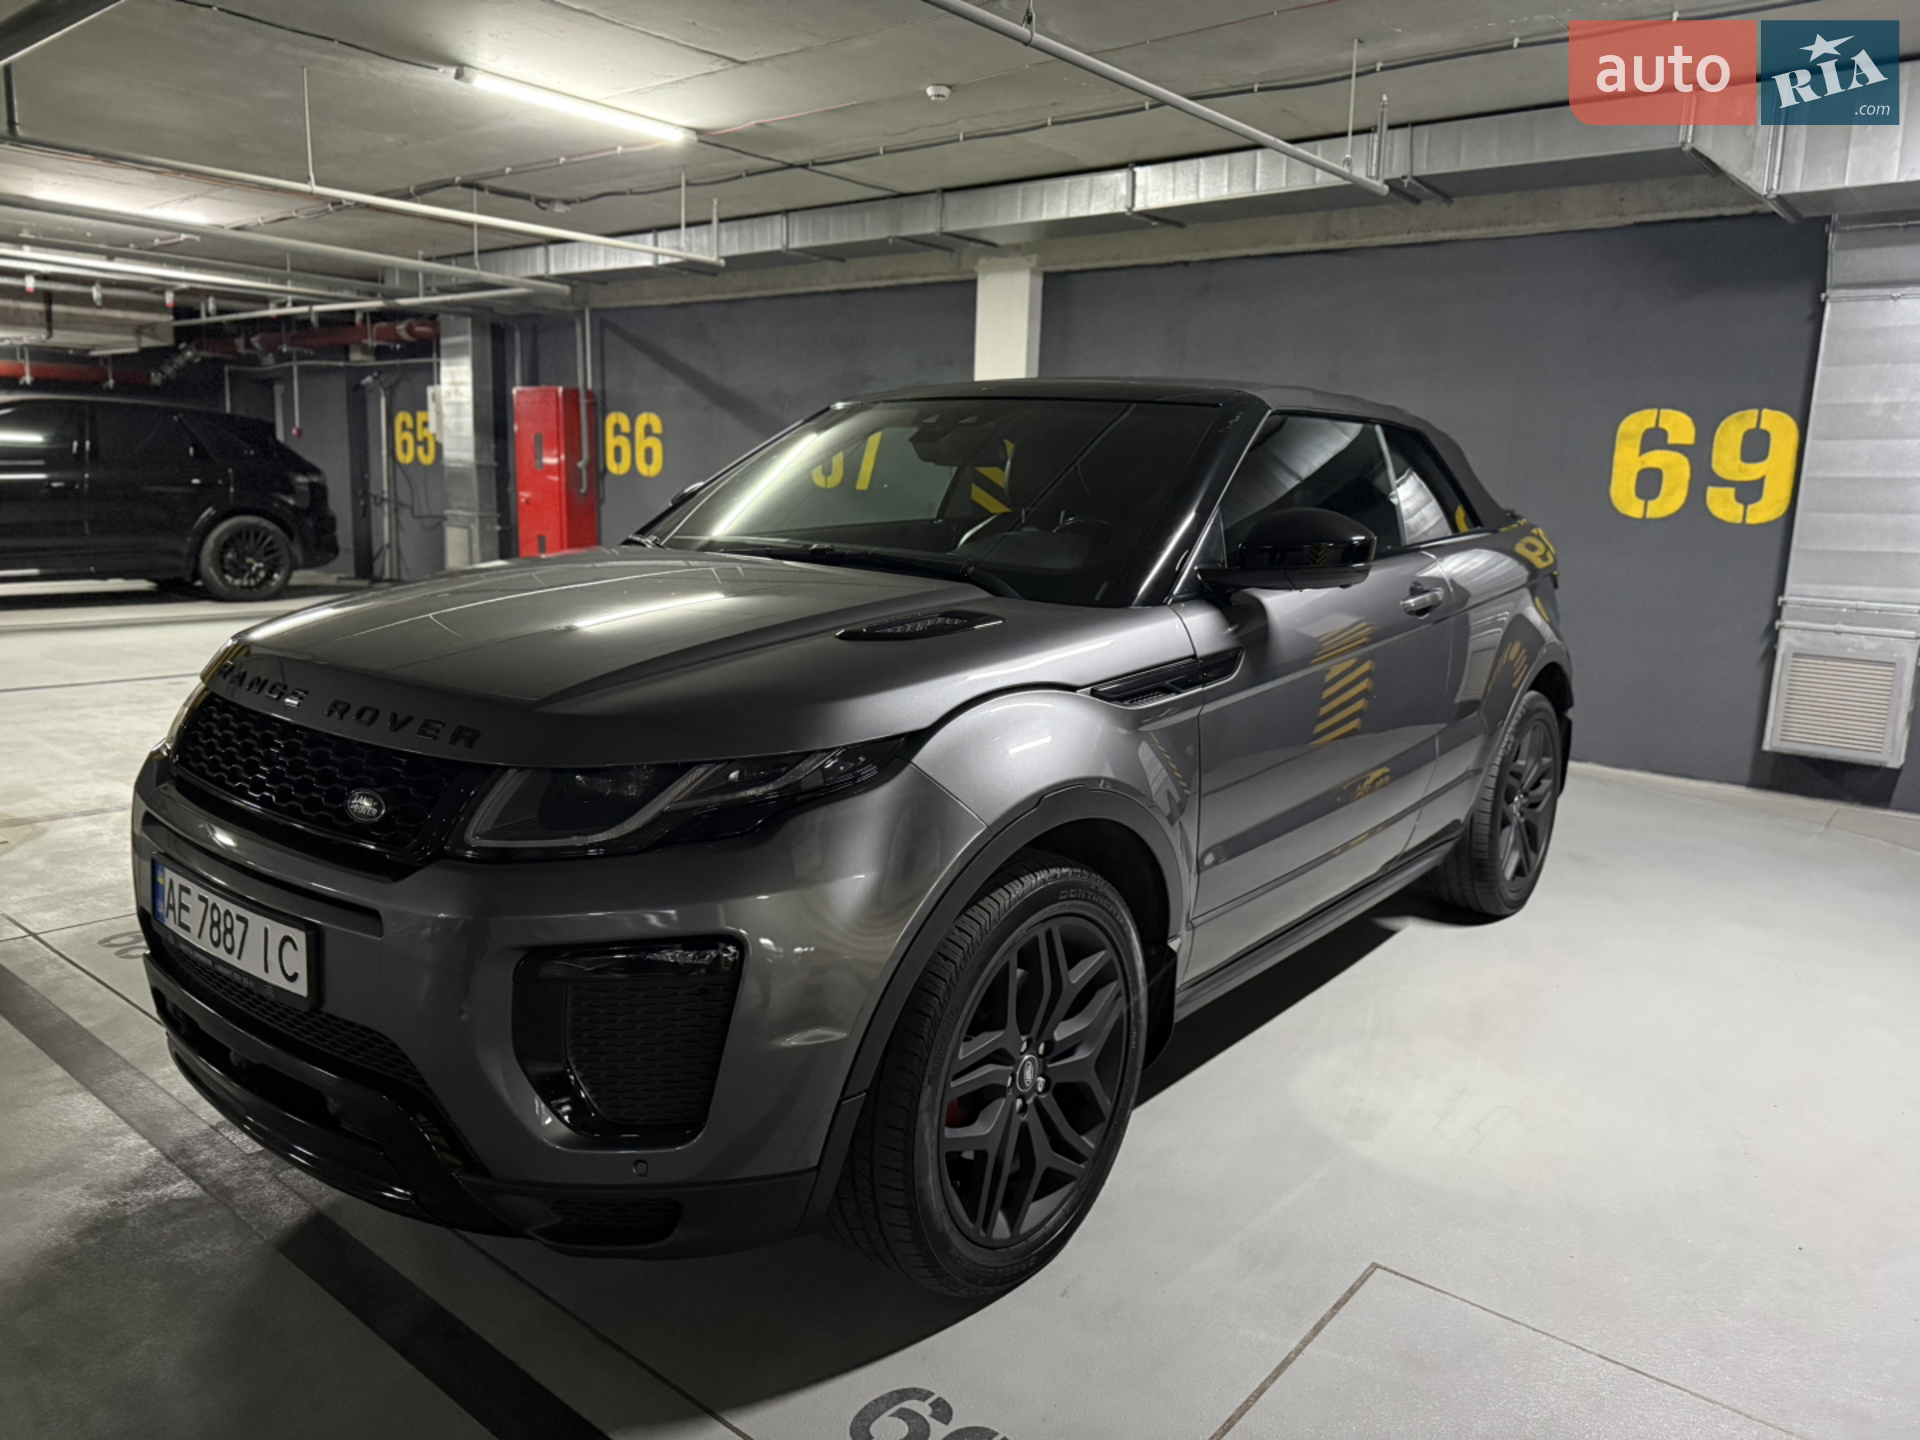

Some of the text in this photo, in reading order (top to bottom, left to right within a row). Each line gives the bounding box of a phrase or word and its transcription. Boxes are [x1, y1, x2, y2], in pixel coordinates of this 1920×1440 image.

[394, 411, 437, 466] 65
[604, 411, 664, 478] 66
[1609, 407, 1800, 525] 69
[215, 660, 482, 749] RANGE ROVER
